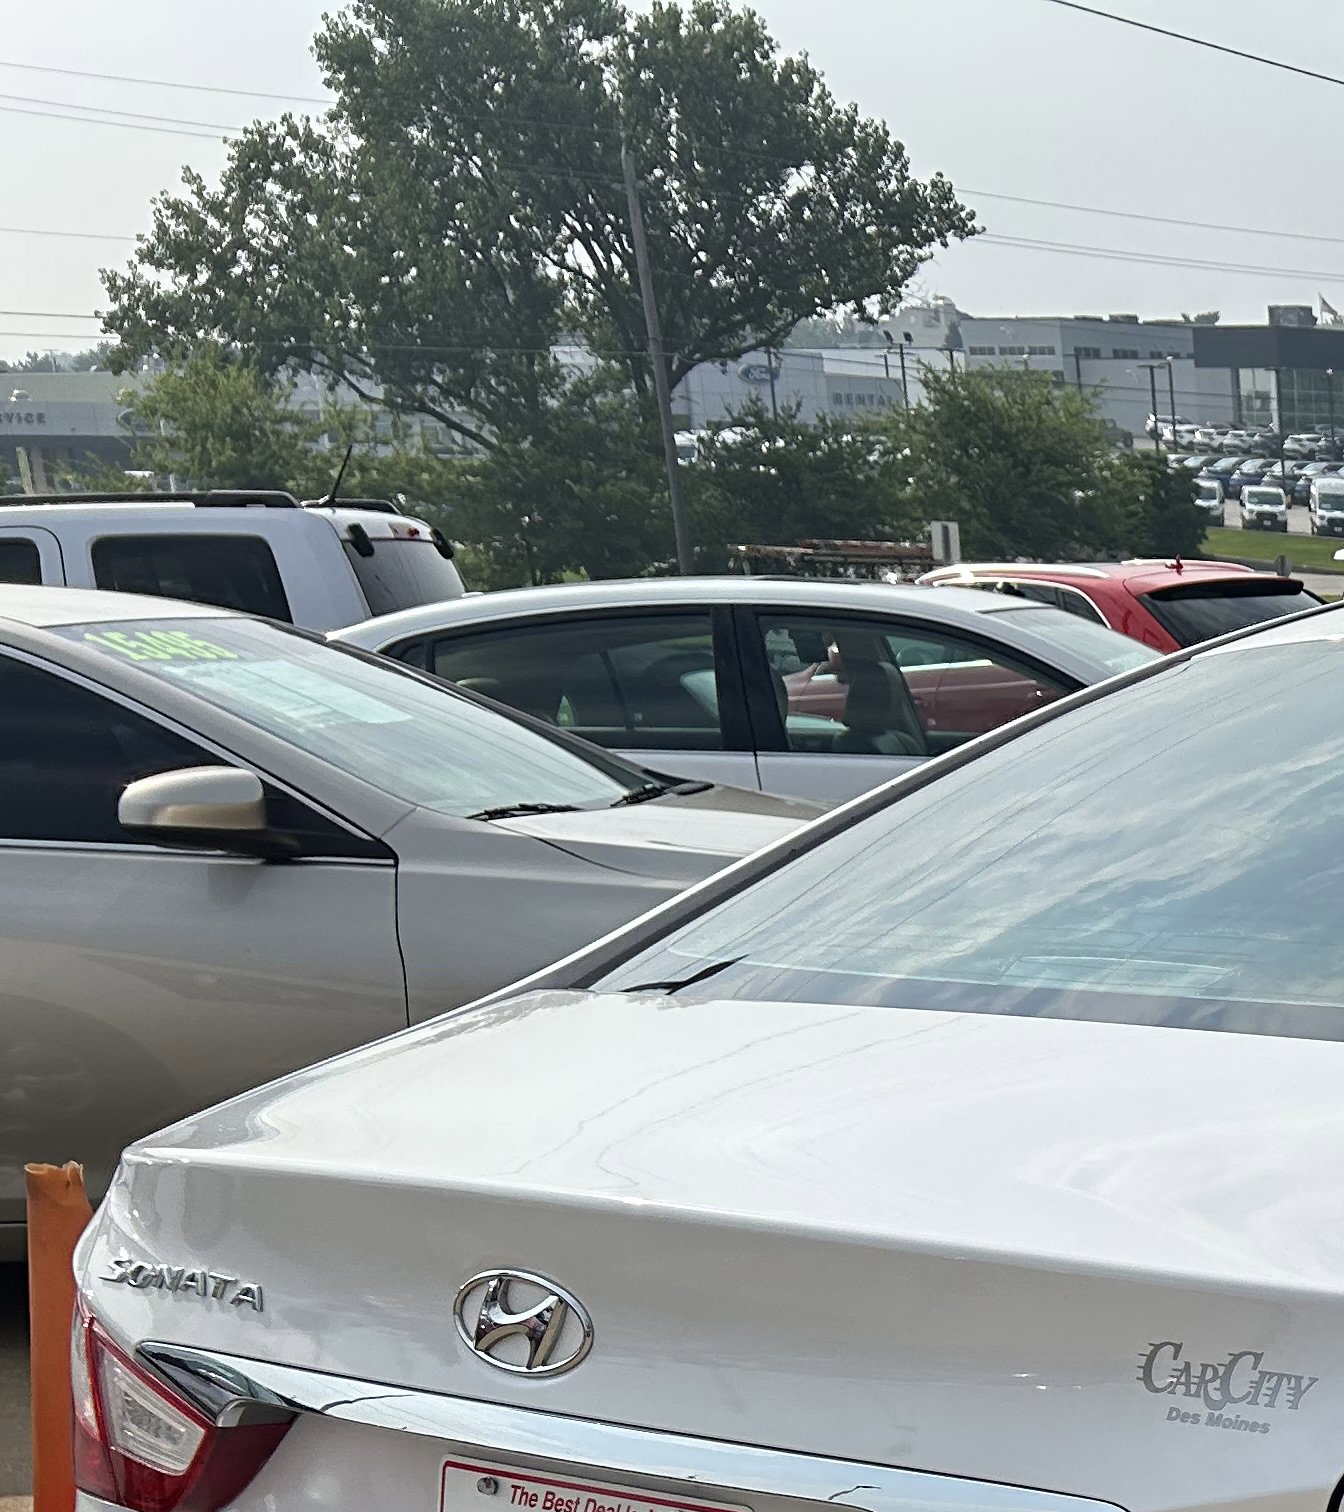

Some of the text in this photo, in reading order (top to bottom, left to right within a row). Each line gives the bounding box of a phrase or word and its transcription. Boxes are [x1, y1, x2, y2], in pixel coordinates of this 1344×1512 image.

[84, 630, 238, 661] 15495
[98, 1258, 264, 1313] SONATA
[1166, 1406, 1271, 1434] Des Moines
[510, 1484, 539, 1508] The
